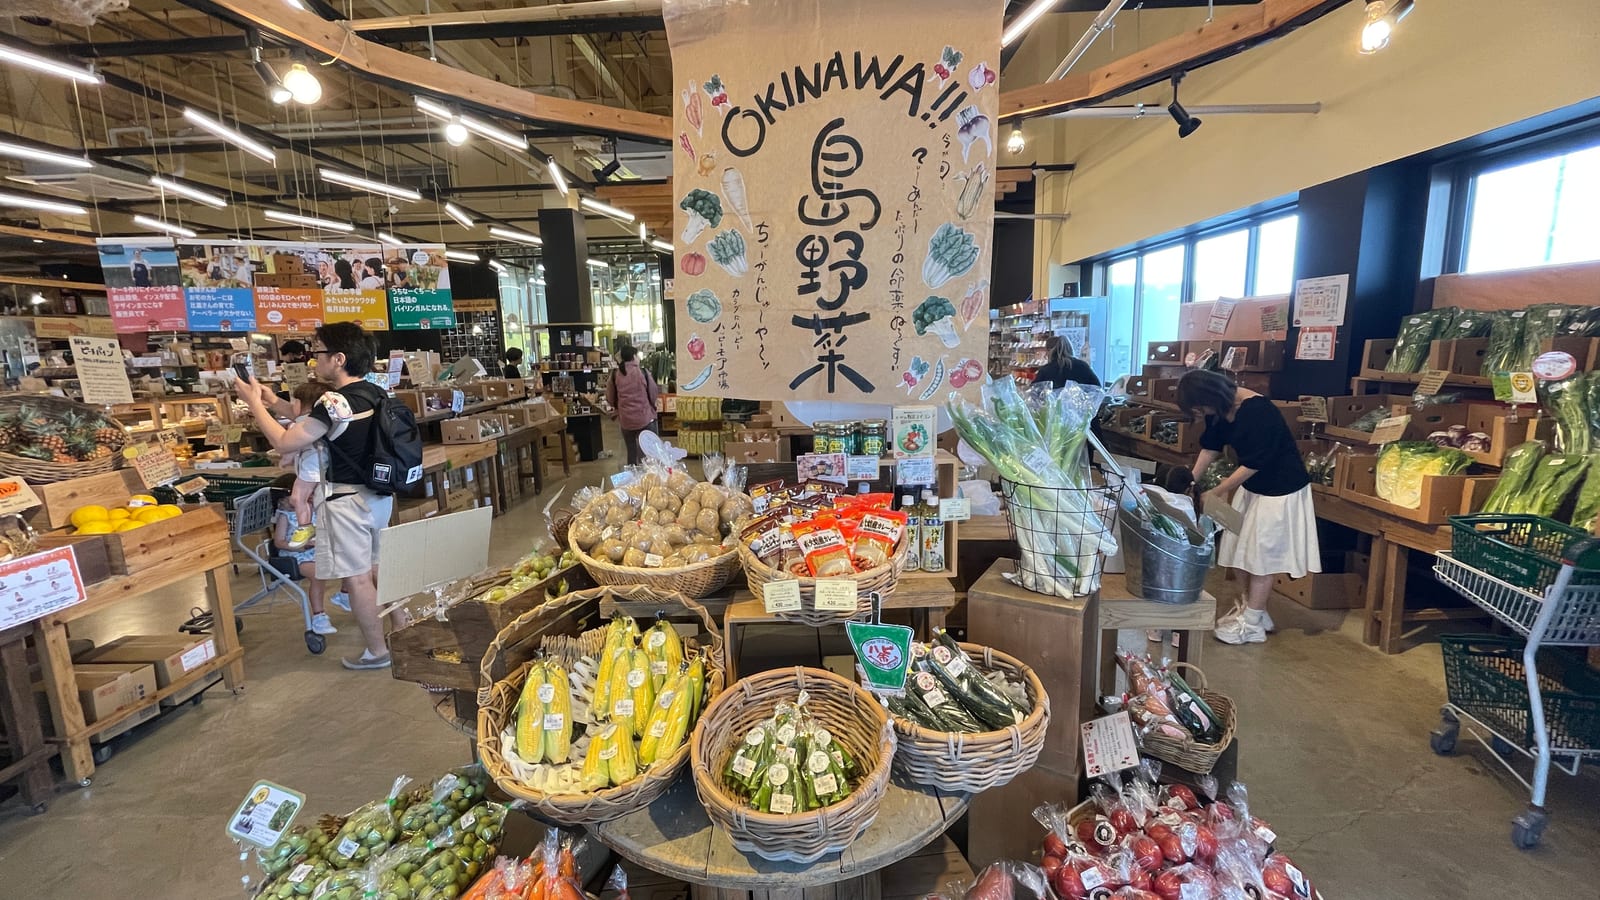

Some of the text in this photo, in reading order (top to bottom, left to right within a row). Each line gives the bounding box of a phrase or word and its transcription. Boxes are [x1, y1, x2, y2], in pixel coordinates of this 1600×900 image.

[789, 117, 881, 393] 島野菜
[393, 296, 418, 304] 日本語の
[712, 322, 730, 390] ハッピーモア市場
